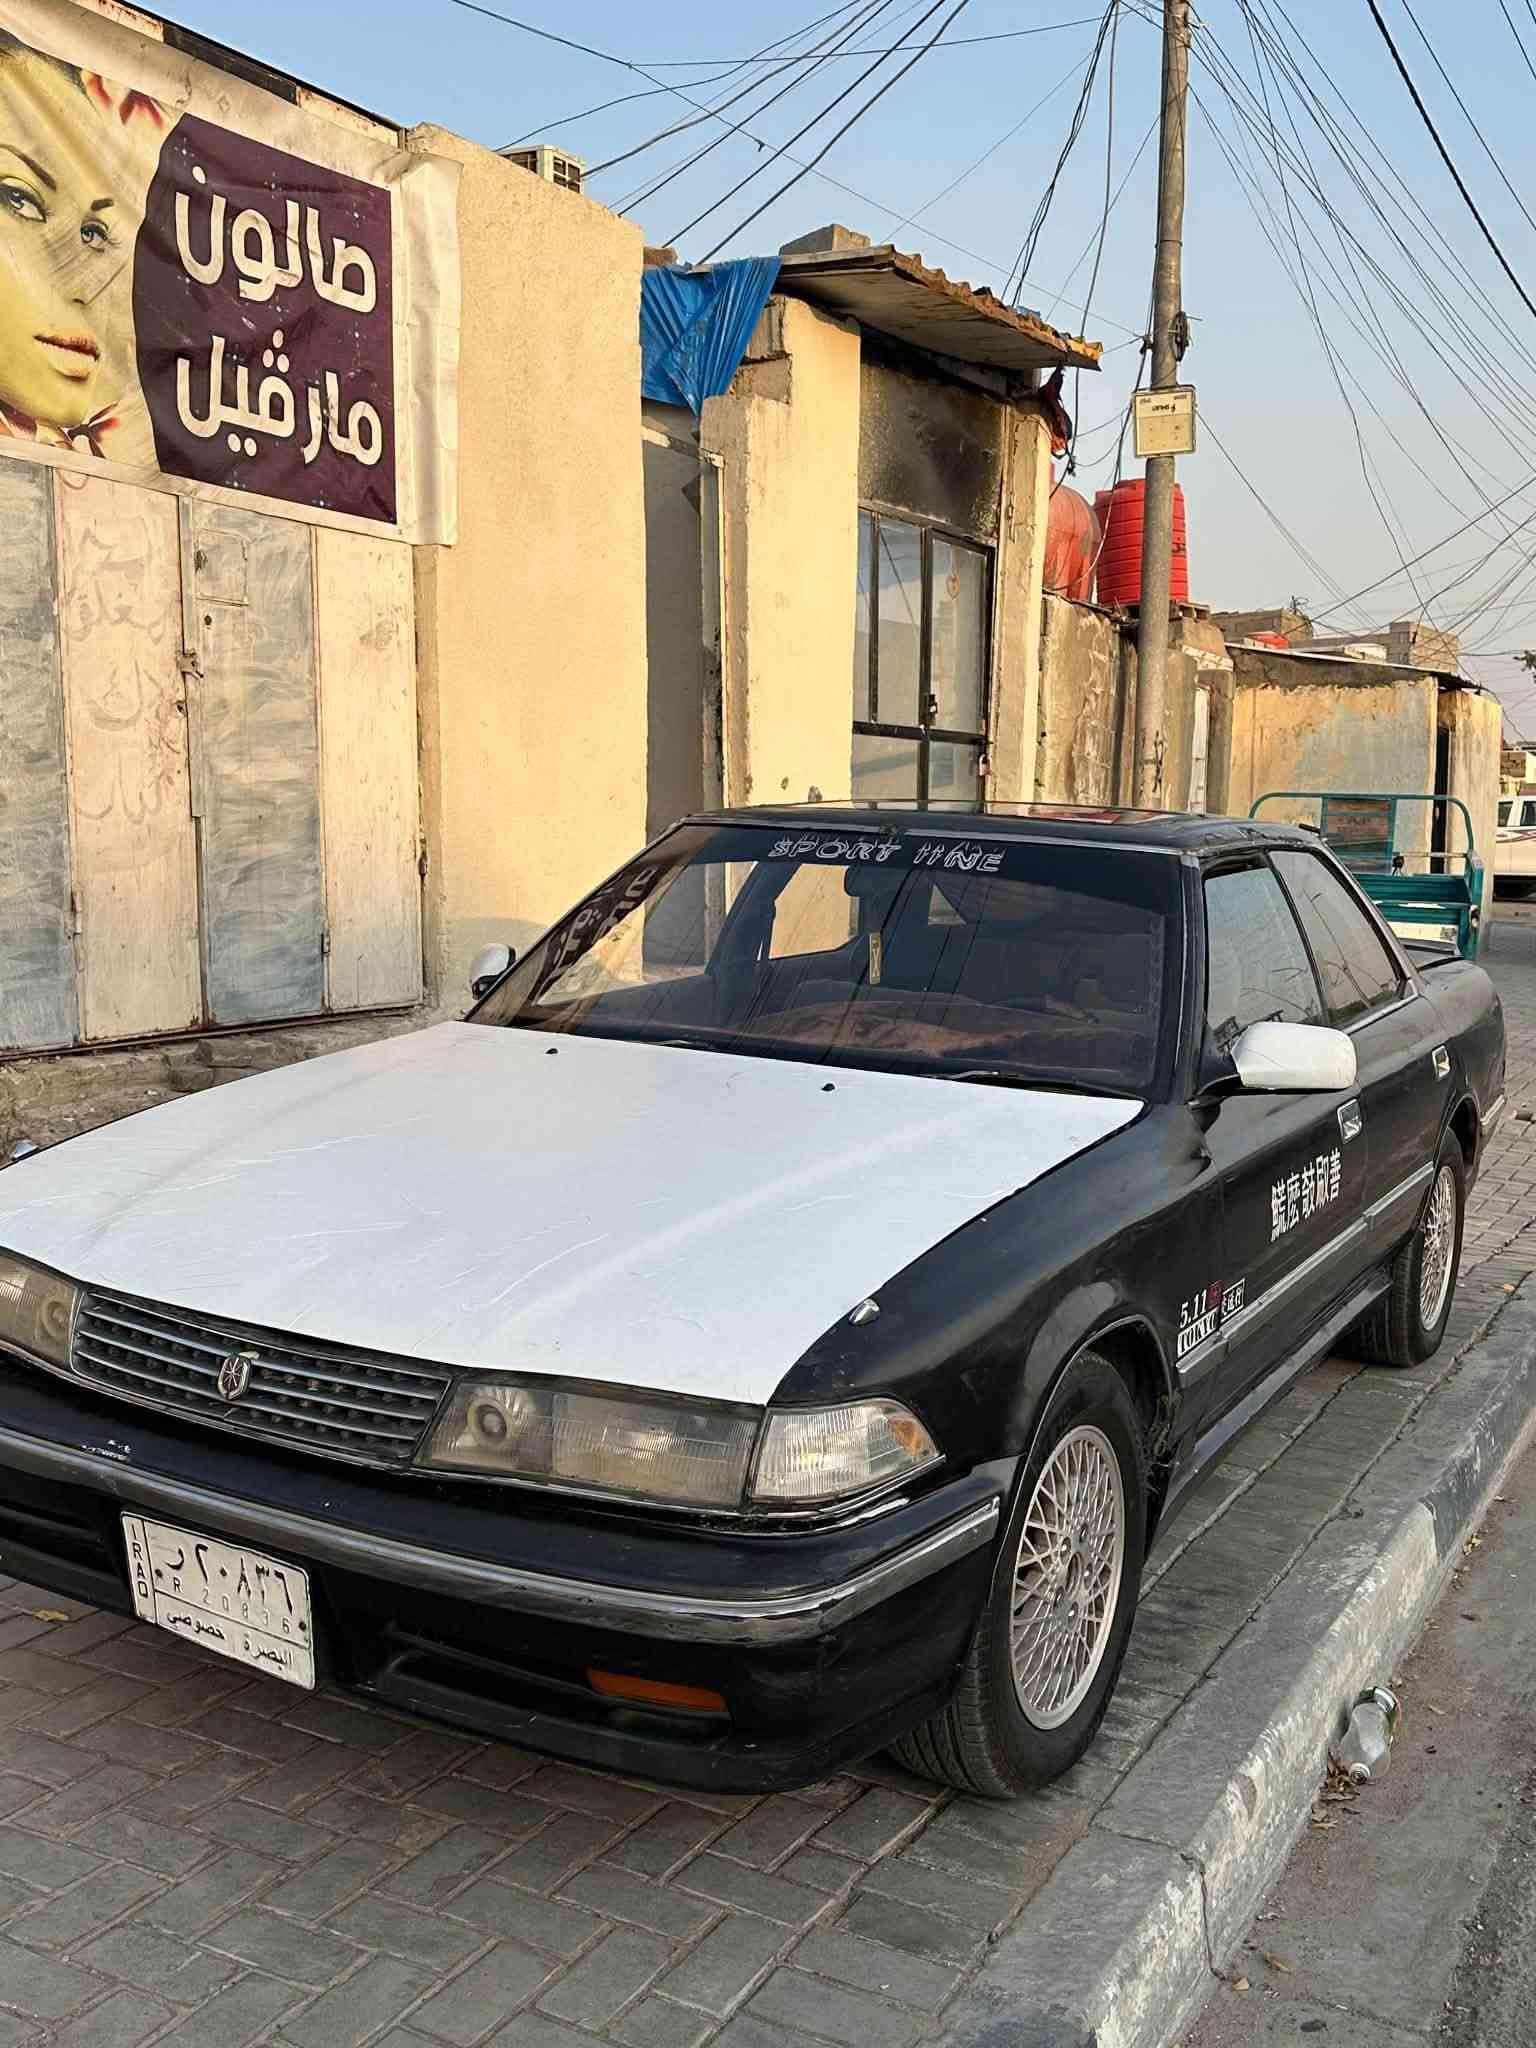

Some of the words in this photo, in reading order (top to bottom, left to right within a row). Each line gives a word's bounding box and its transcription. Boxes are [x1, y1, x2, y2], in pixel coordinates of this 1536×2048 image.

[175, 166, 376, 313] صالون
[768, 835, 902, 863] SPORT
[1179, 1289, 1208, 1329] 5.11
[132, 1524, 149, 1599] IRAQ
[243, 1632, 295, 1671] البصرة
